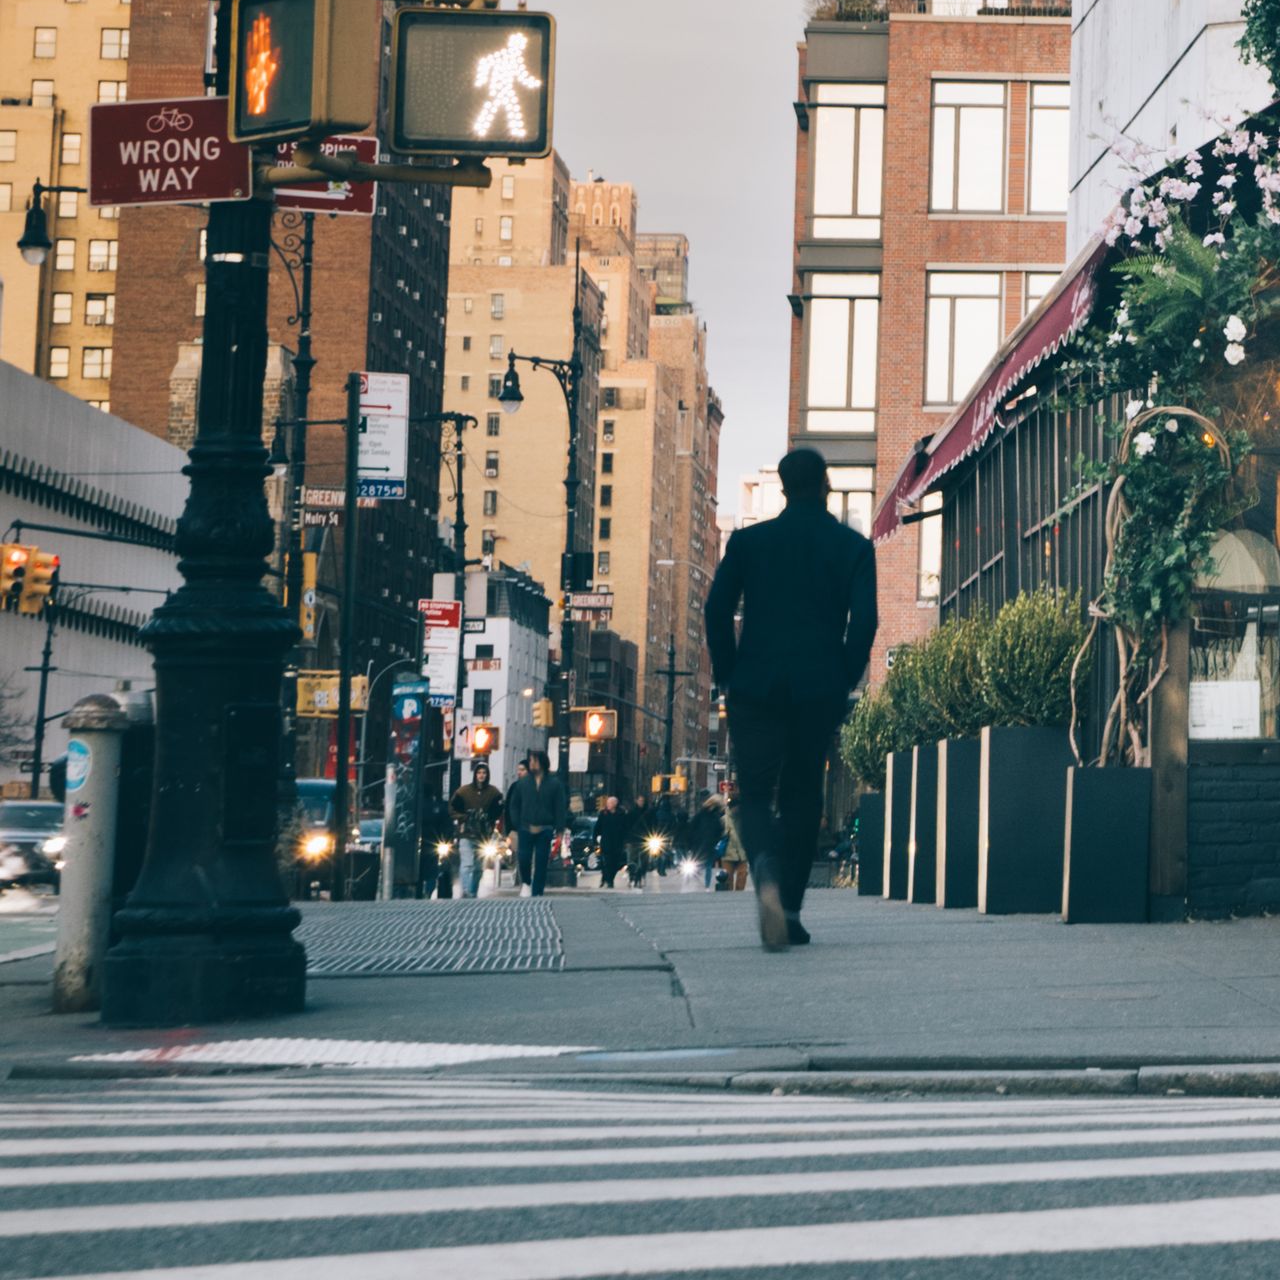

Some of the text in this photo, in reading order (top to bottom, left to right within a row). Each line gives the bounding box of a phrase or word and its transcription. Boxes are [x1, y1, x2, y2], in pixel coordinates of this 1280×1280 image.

[119, 136, 221, 165] WRONG
[138, 166, 200, 193] WAY
[306, 489, 362, 506] GREENW
[600, 609, 611, 621] ST
